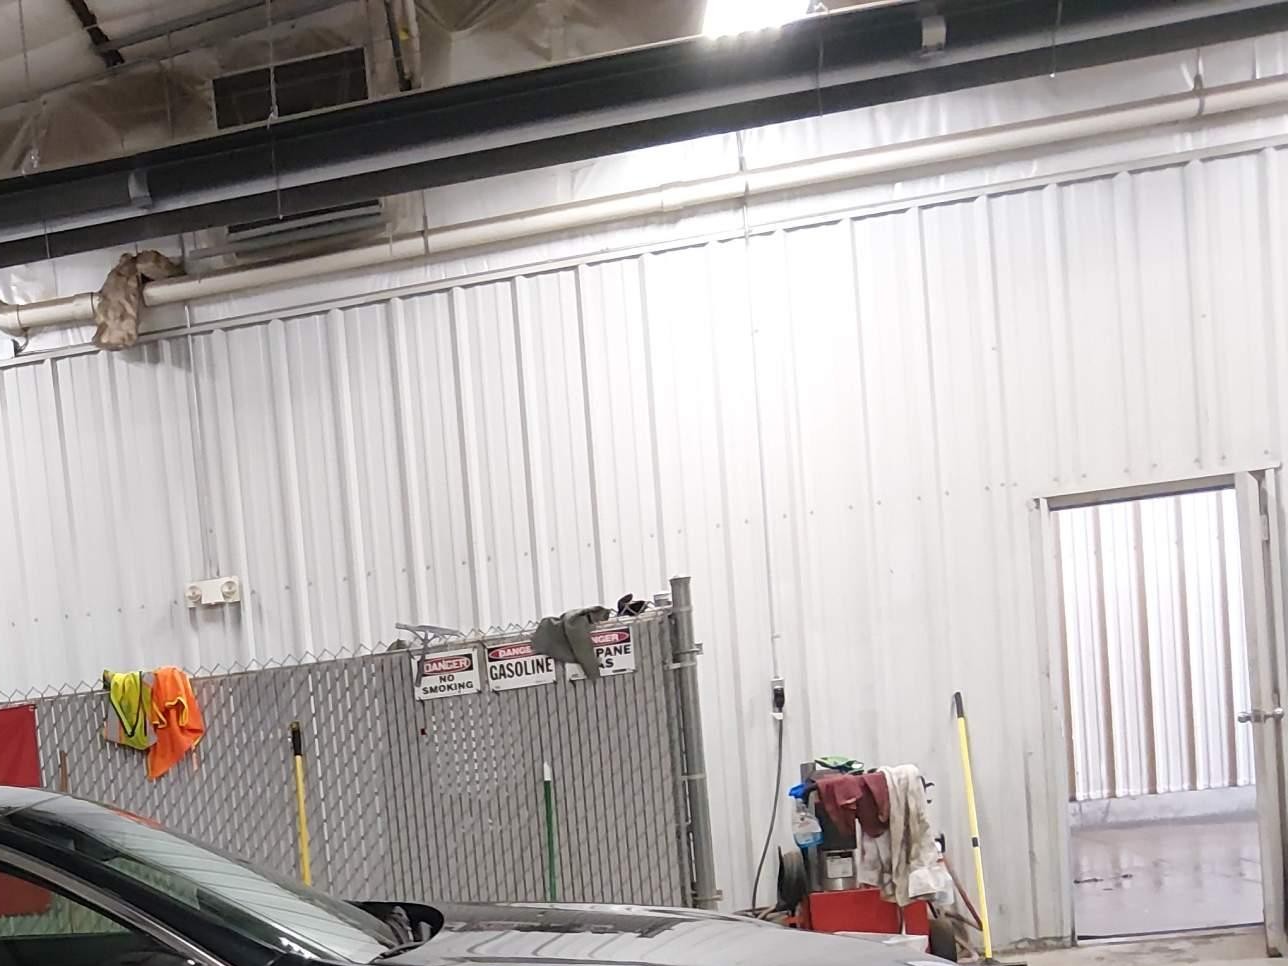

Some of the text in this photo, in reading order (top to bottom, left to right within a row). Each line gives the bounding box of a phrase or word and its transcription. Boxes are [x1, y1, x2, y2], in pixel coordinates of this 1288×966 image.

[591, 633, 619, 644] NGER
[498, 645, 533, 657] DANGE
[595, 644, 631, 658] PANE
[423, 659, 468, 672] DANGER
[489, 656, 553, 680] GASOLINE
[439, 674, 455, 683] NO
[422, 680, 473, 695] SMOKING
